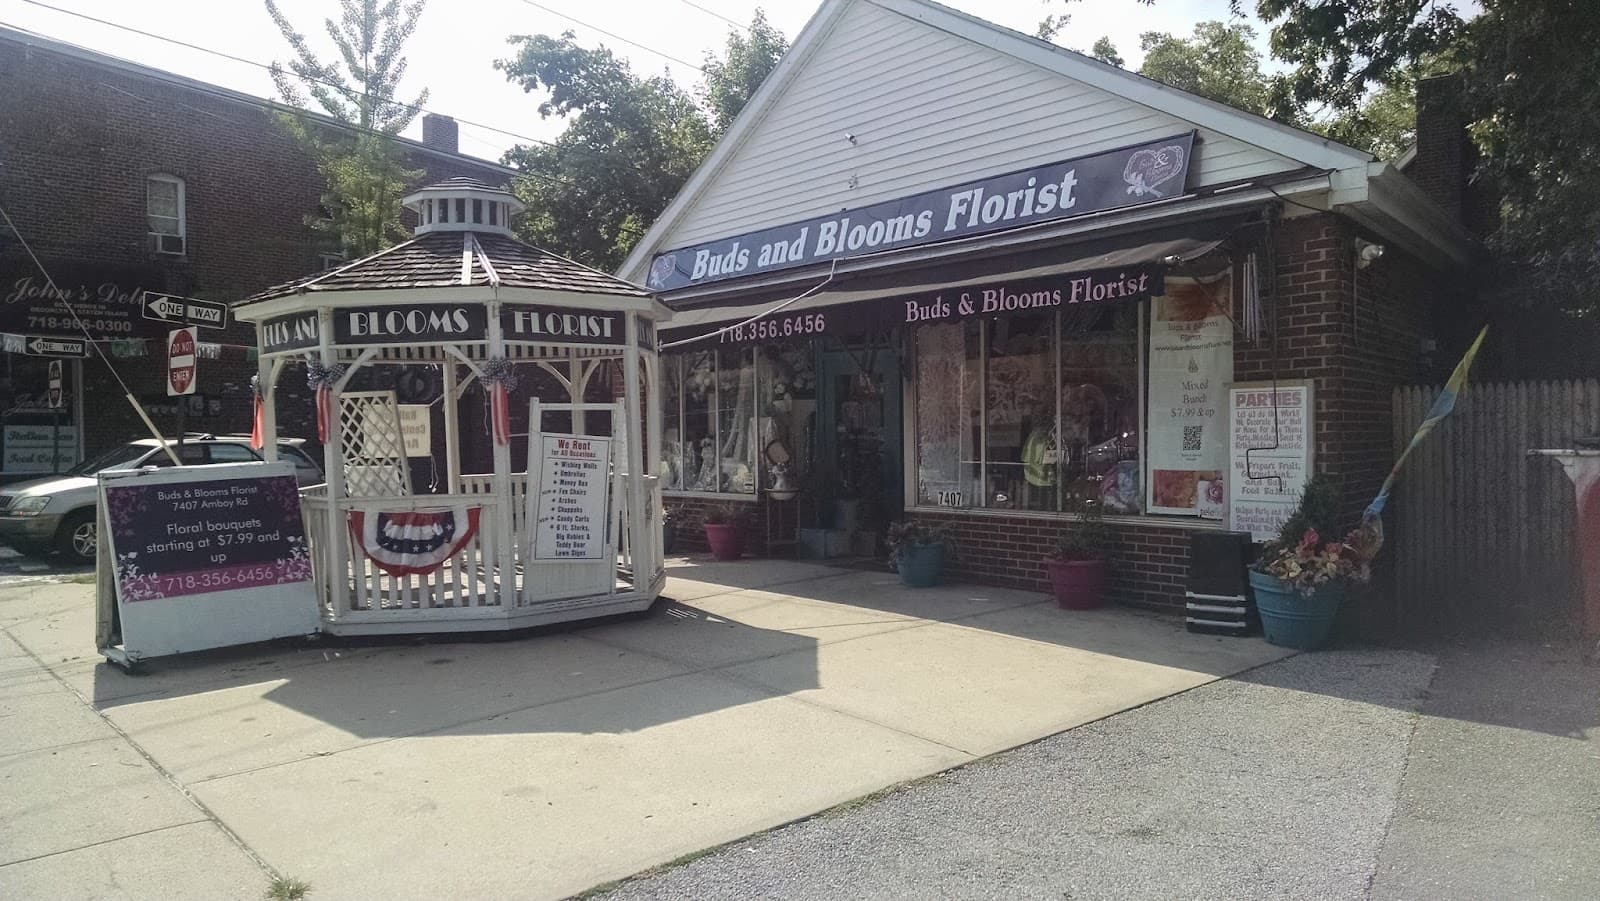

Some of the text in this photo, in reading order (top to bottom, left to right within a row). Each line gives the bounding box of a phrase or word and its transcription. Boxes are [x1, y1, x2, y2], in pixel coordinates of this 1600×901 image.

[690, 169, 1078, 280] Buds and Blooms Florist
[905, 271, 1149, 322] Buds & Blooms Florist
[159, 302, 218, 320] ONE WAY
[350, 309, 469, 336] BLOOMS
[514, 311, 616, 338] FLORIST
[719, 313, 826, 344] 718.356.6456
[36, 342, 81, 353] ONE WAY
[172, 341, 193, 353] DO NOT
[1182, 380, 1208, 391] Mixed
[1236, 391, 1302, 408] PARTIES
[1170, 408, 1195, 418] $7.99
[558, 439, 590, 451] We Rent
[158, 491, 182, 500] Buds
[184, 490, 191, 498] &
[193, 488, 229, 498] Blooms
[938, 491, 961, 506] 7407
[1242, 487, 1260, 495] Food
[172, 497, 248, 511] 7407 Amboy Rd
[166, 518, 262, 535] Floral bouquets
[146, 530, 280, 553] starting at $7.99 and
[556, 541, 572, 549] Teddy
[210, 553, 227, 564] up
[165, 567, 274, 591] 718-356-6456
